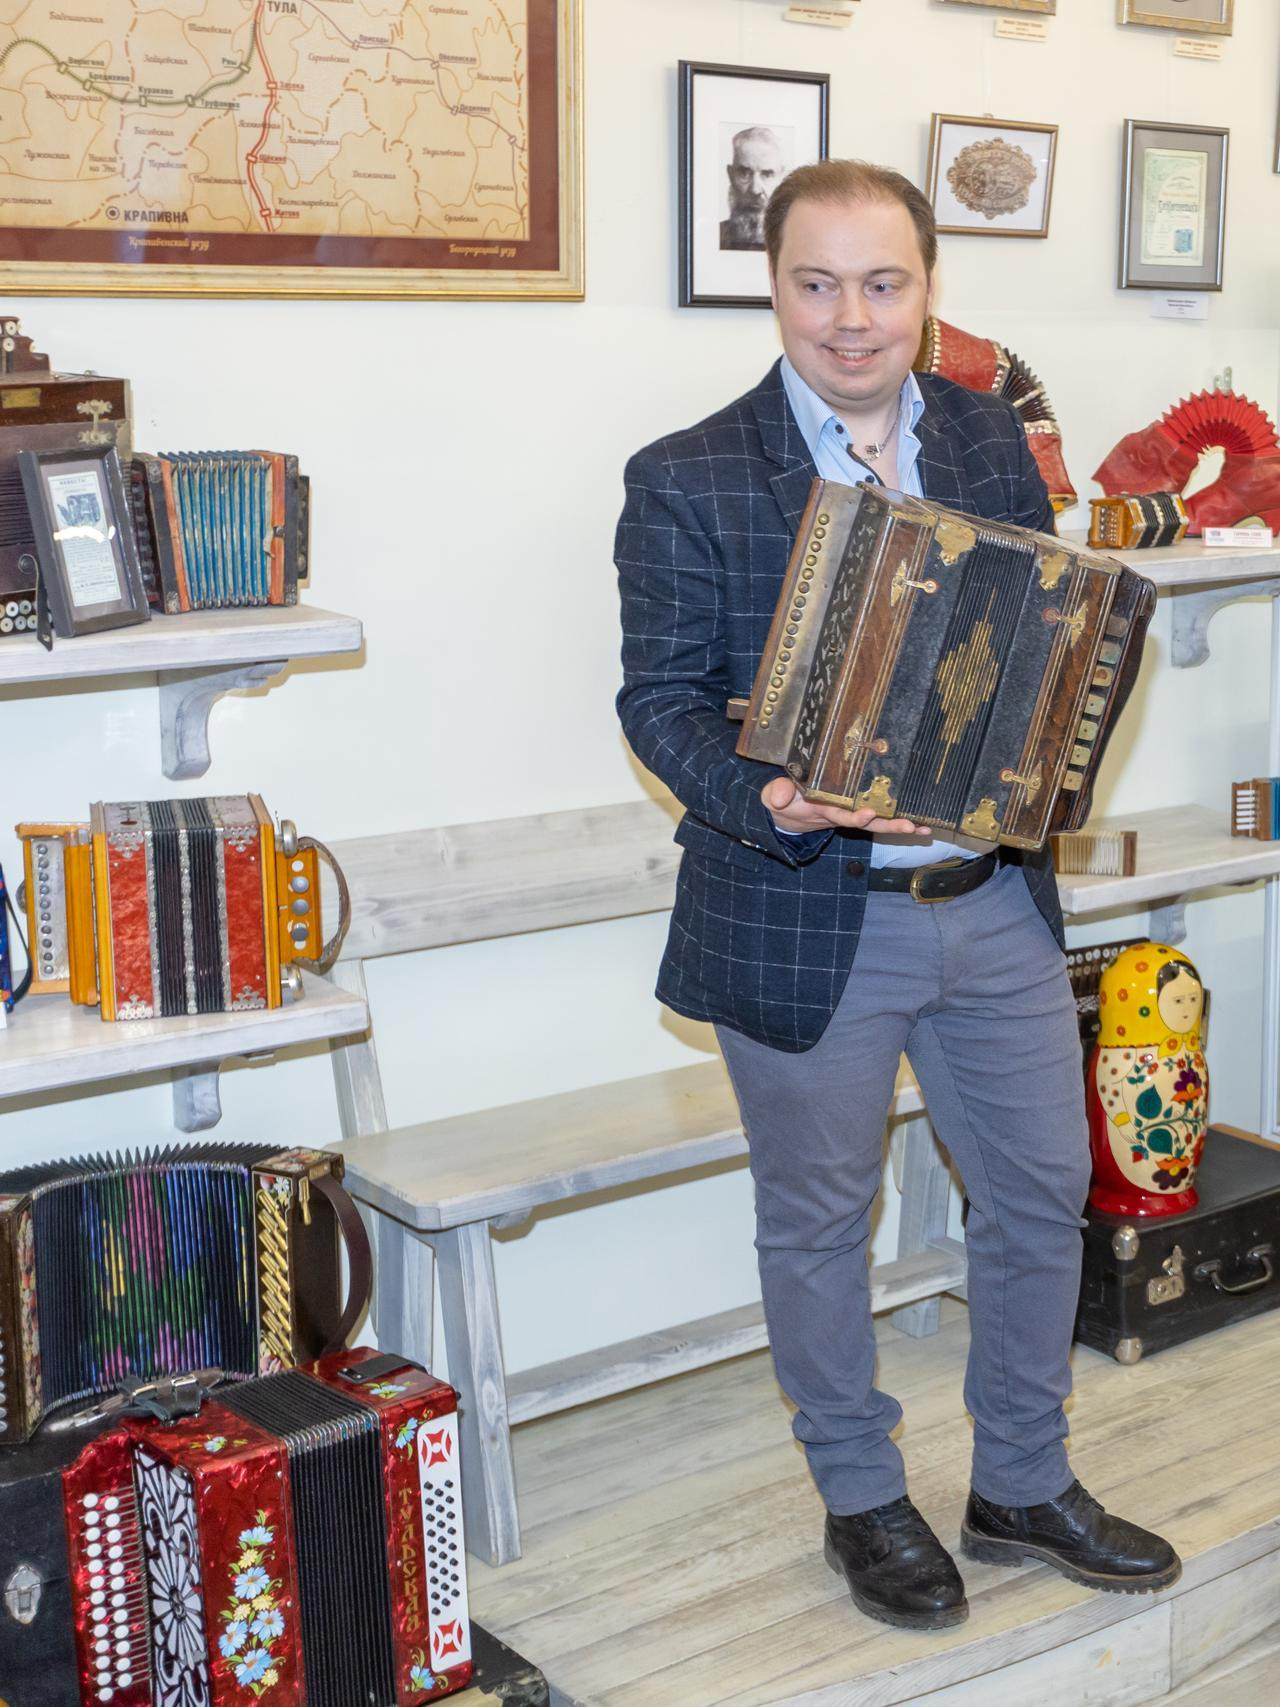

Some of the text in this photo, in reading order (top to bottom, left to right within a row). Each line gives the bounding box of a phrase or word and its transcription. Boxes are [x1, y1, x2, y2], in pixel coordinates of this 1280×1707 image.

[267, 1, 298, 14] ТУЛА
[124, 210, 189, 223] КРАПИВНА
[129, 236, 189, 249] Крапивенский
[399, 1487, 421, 1633] ТУЛЬСКАЯ
